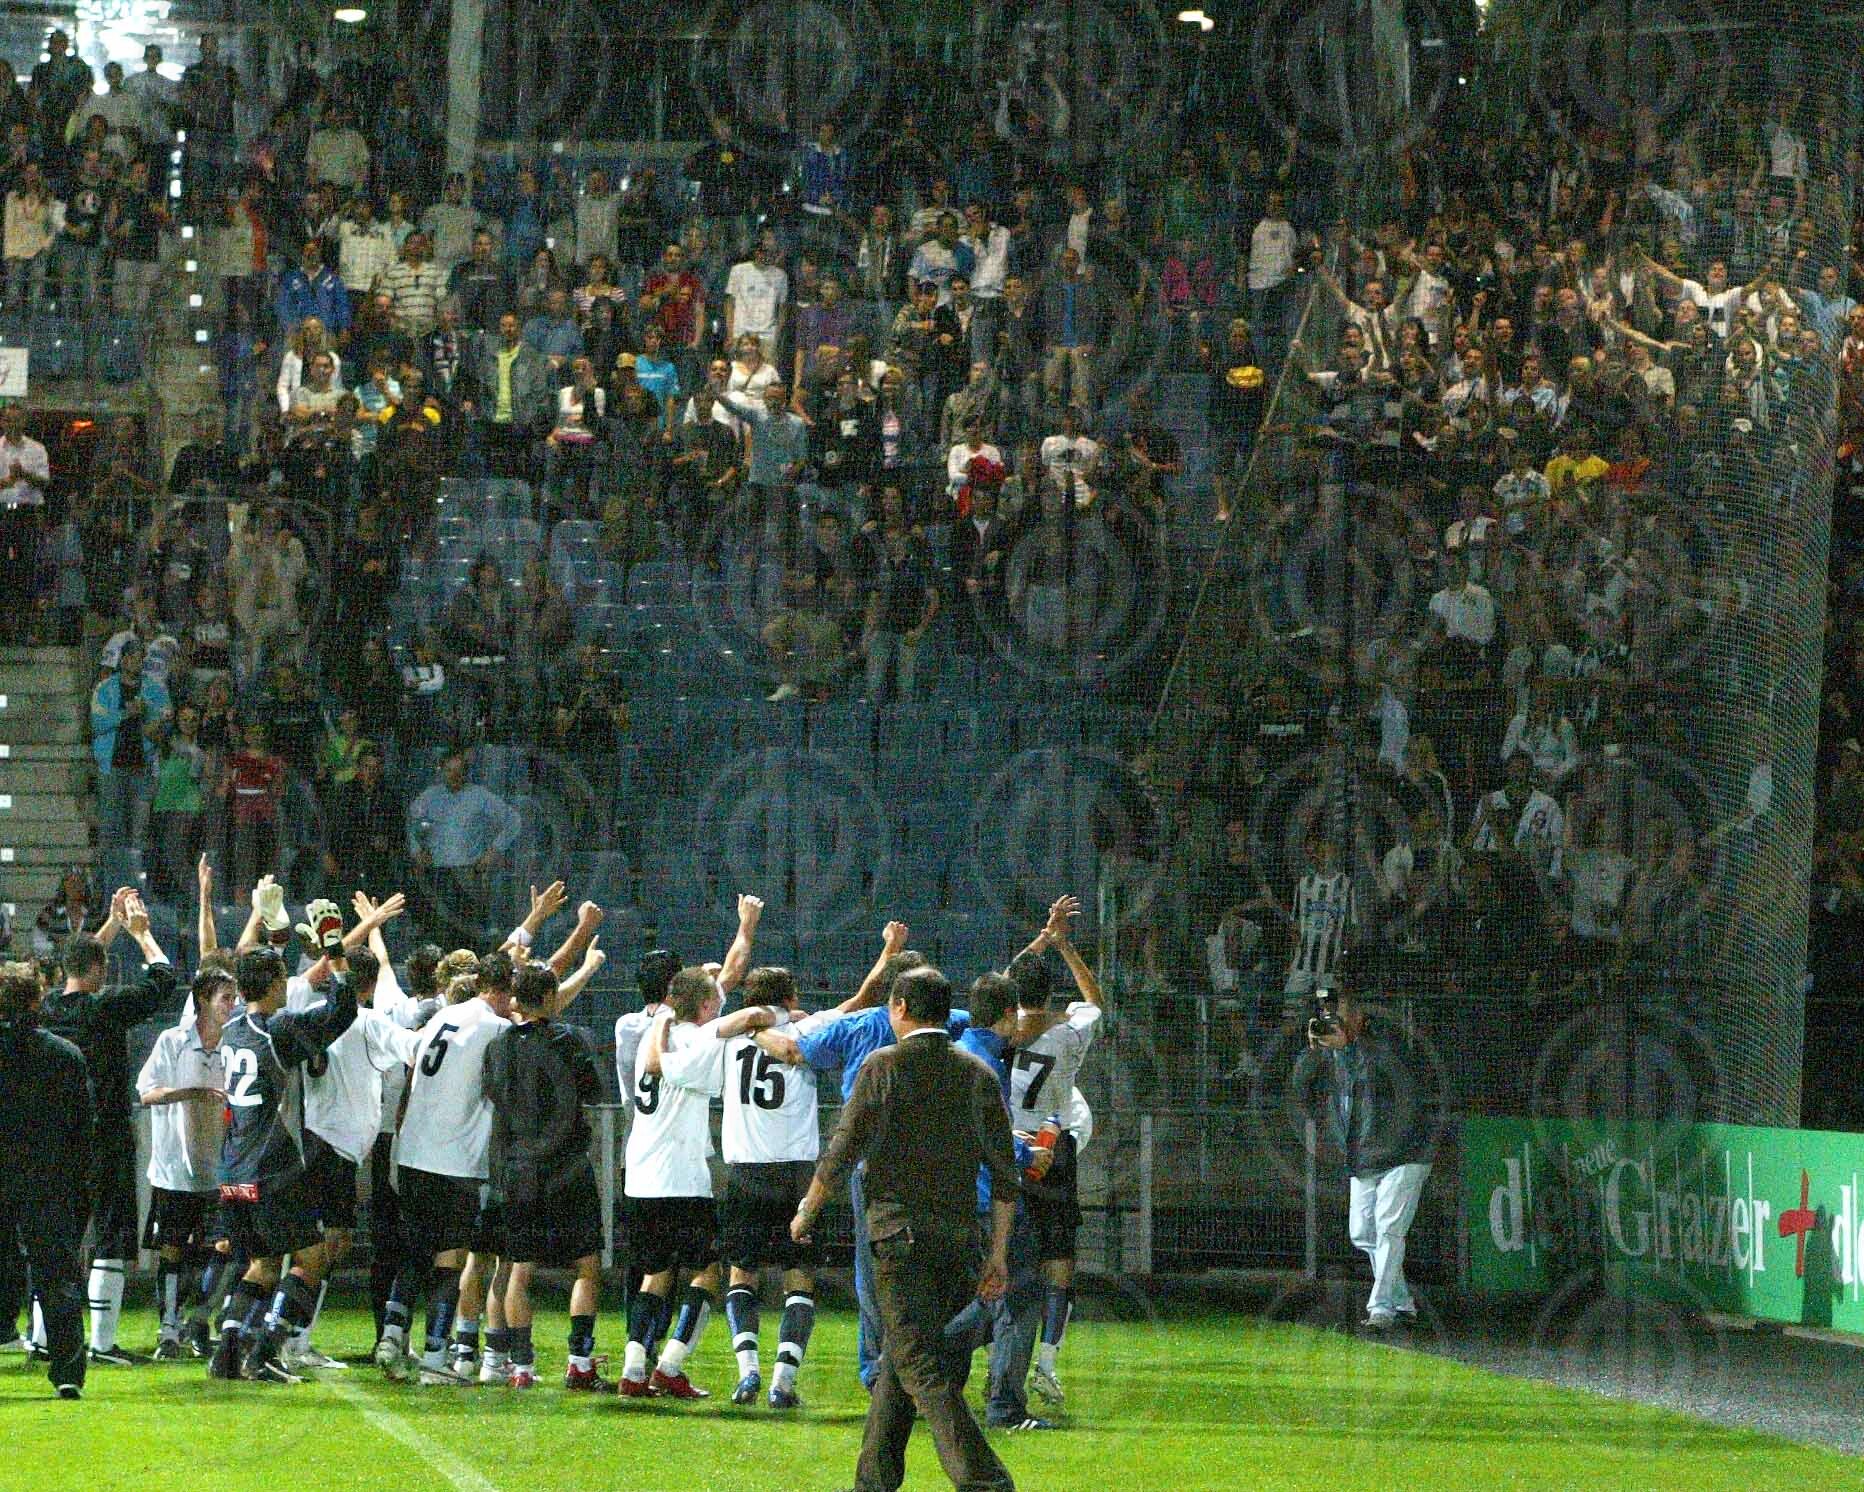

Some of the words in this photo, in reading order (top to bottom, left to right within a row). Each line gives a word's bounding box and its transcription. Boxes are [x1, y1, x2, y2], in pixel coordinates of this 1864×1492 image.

[421, 1023, 459, 1077] 5
[735, 1045, 786, 1110] 15
[634, 1072, 660, 1116] 9
[1605, 1158, 1770, 1272] Grazer
